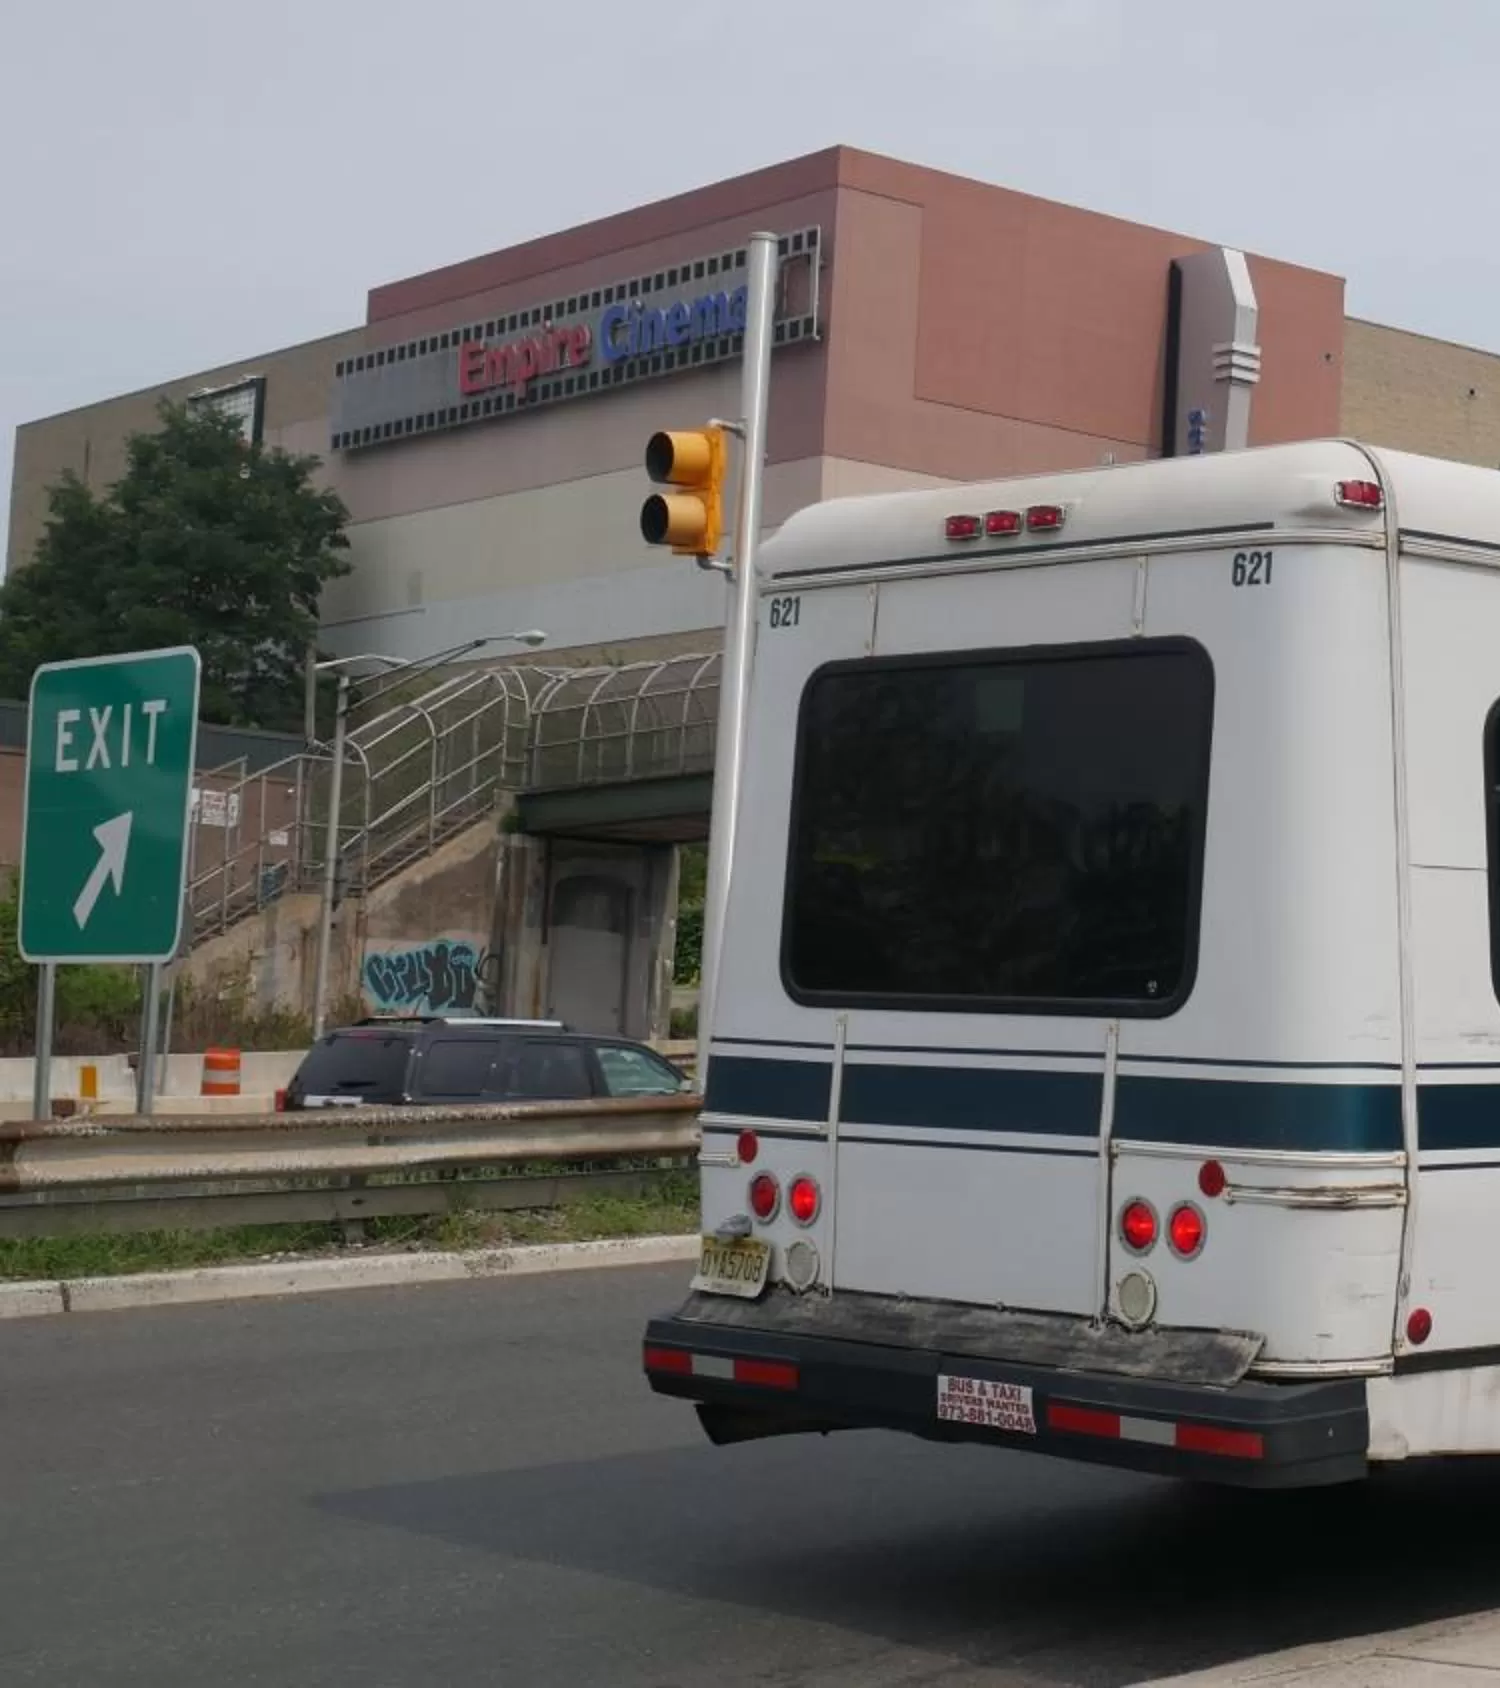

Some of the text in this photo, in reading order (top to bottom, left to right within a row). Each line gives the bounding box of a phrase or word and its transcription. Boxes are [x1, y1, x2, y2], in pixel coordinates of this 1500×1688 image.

[457, 319, 592, 396] Empire
[1232, 551, 1273, 586] 621
[769, 597, 800, 628] 621
[54, 699, 167, 773] EXIT
[948, 1377, 974, 1394] BUS
[992, 1384, 1021, 1401] TAXI
